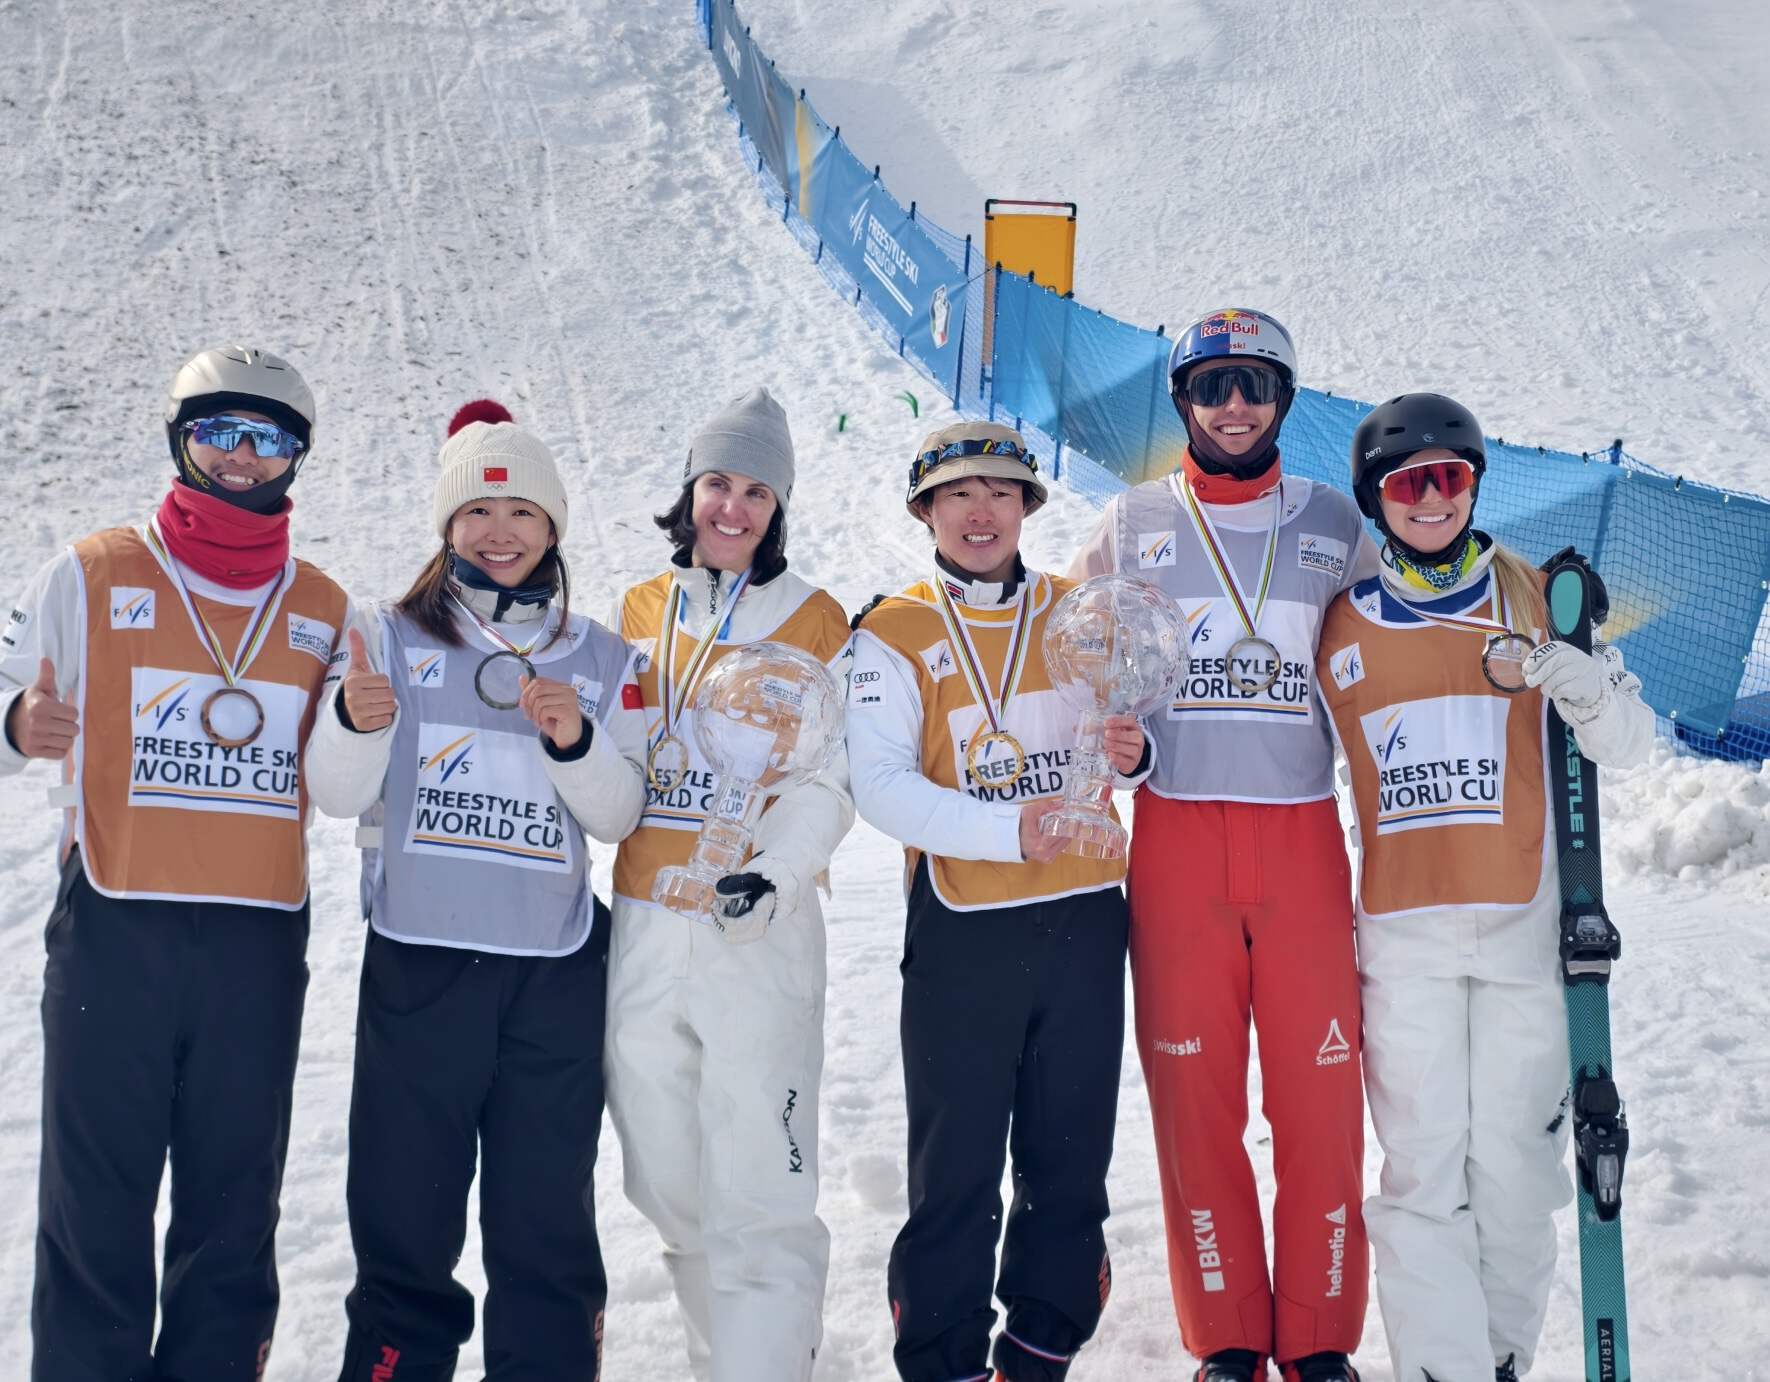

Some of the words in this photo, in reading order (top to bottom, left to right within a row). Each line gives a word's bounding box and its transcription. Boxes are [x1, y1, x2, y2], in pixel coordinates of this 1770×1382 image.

[867, 213, 905, 272] FREESTYLE
[904, 256, 920, 288] SKI
[1201, 321, 1230, 338] Red
[1231, 322, 1259, 336] Bull
[1365, 447, 1382, 460] bern
[1301, 550, 1335, 561] FREESTYLE
[1301, 556, 1329, 567] WORLD
[1330, 563, 1344, 571] CUP
[292, 636, 320, 650] WORLD
[1267, 681, 1309, 703] CUP
[135, 737, 264, 765] FREESTYLE
[272, 750, 298, 769] SK
[134, 759, 242, 788] WORLD
[968, 771, 1064, 802] WORLD
[1380, 758, 1469, 787] REESTYLE
[418, 787, 538, 819] FREESTYLE
[1461, 779, 1500, 801] CU
[416, 808, 515, 841] WORLD
[524, 824, 564, 850] CUP
[1191, 1209, 1221, 1268] BKW
[1326, 1228, 1346, 1297] helvetia
[1600, 1328, 1612, 1380] AERIAL
